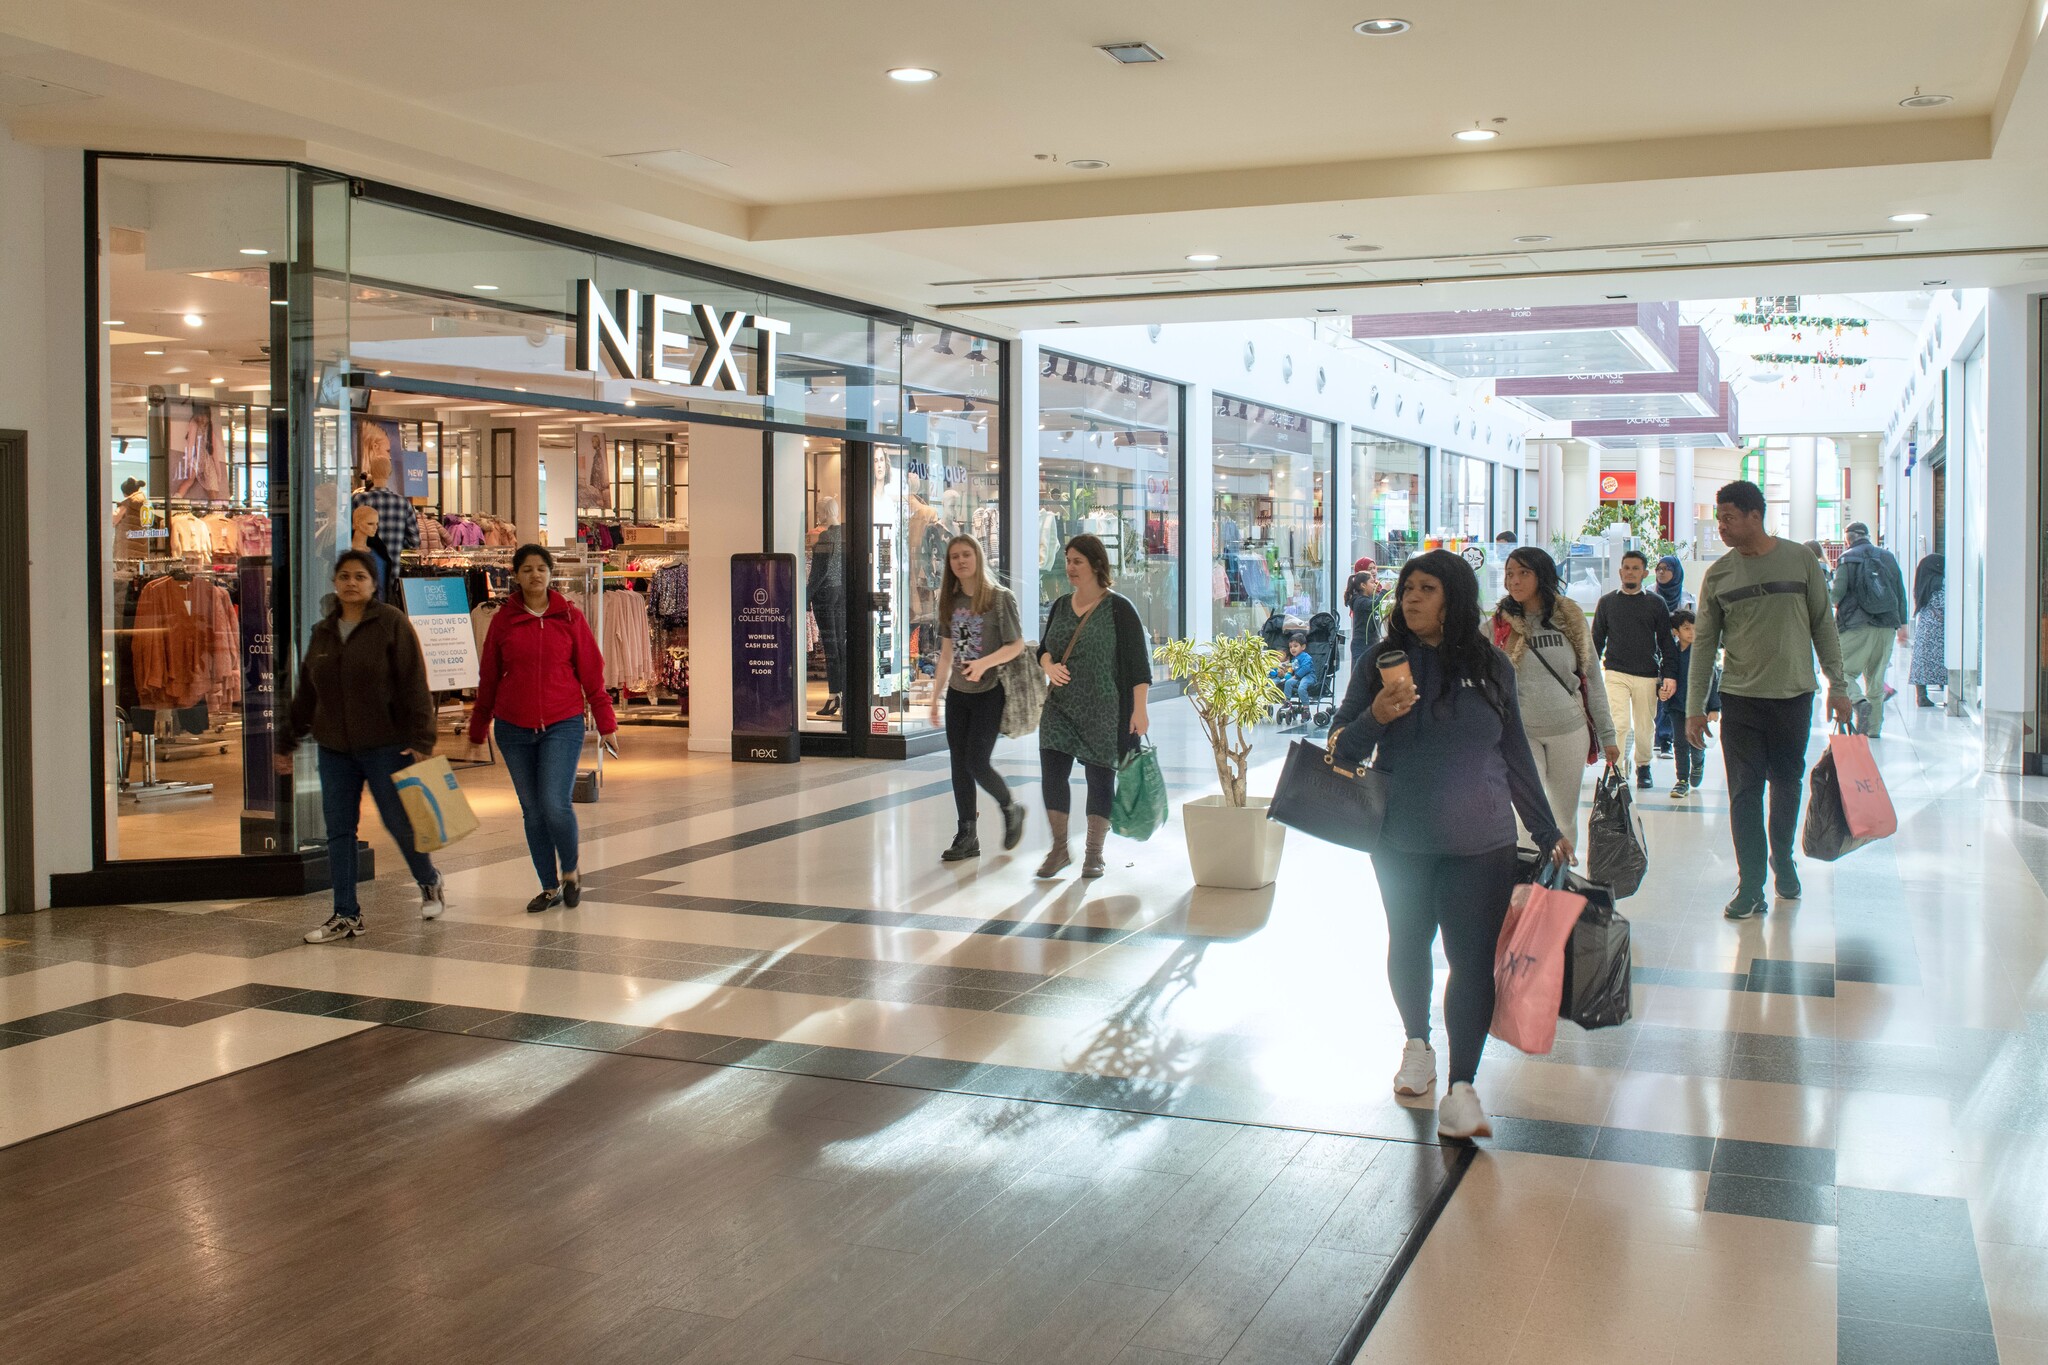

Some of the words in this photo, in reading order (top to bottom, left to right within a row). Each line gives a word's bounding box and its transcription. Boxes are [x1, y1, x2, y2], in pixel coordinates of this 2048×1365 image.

[576, 278, 791, 397] NEXT
[407, 468, 424, 477] NEW
[424, 585, 446, 594] next
[425, 593, 448, 601] LOVES
[1531, 634, 1564, 649] UMA
[751, 748, 778, 759] next
